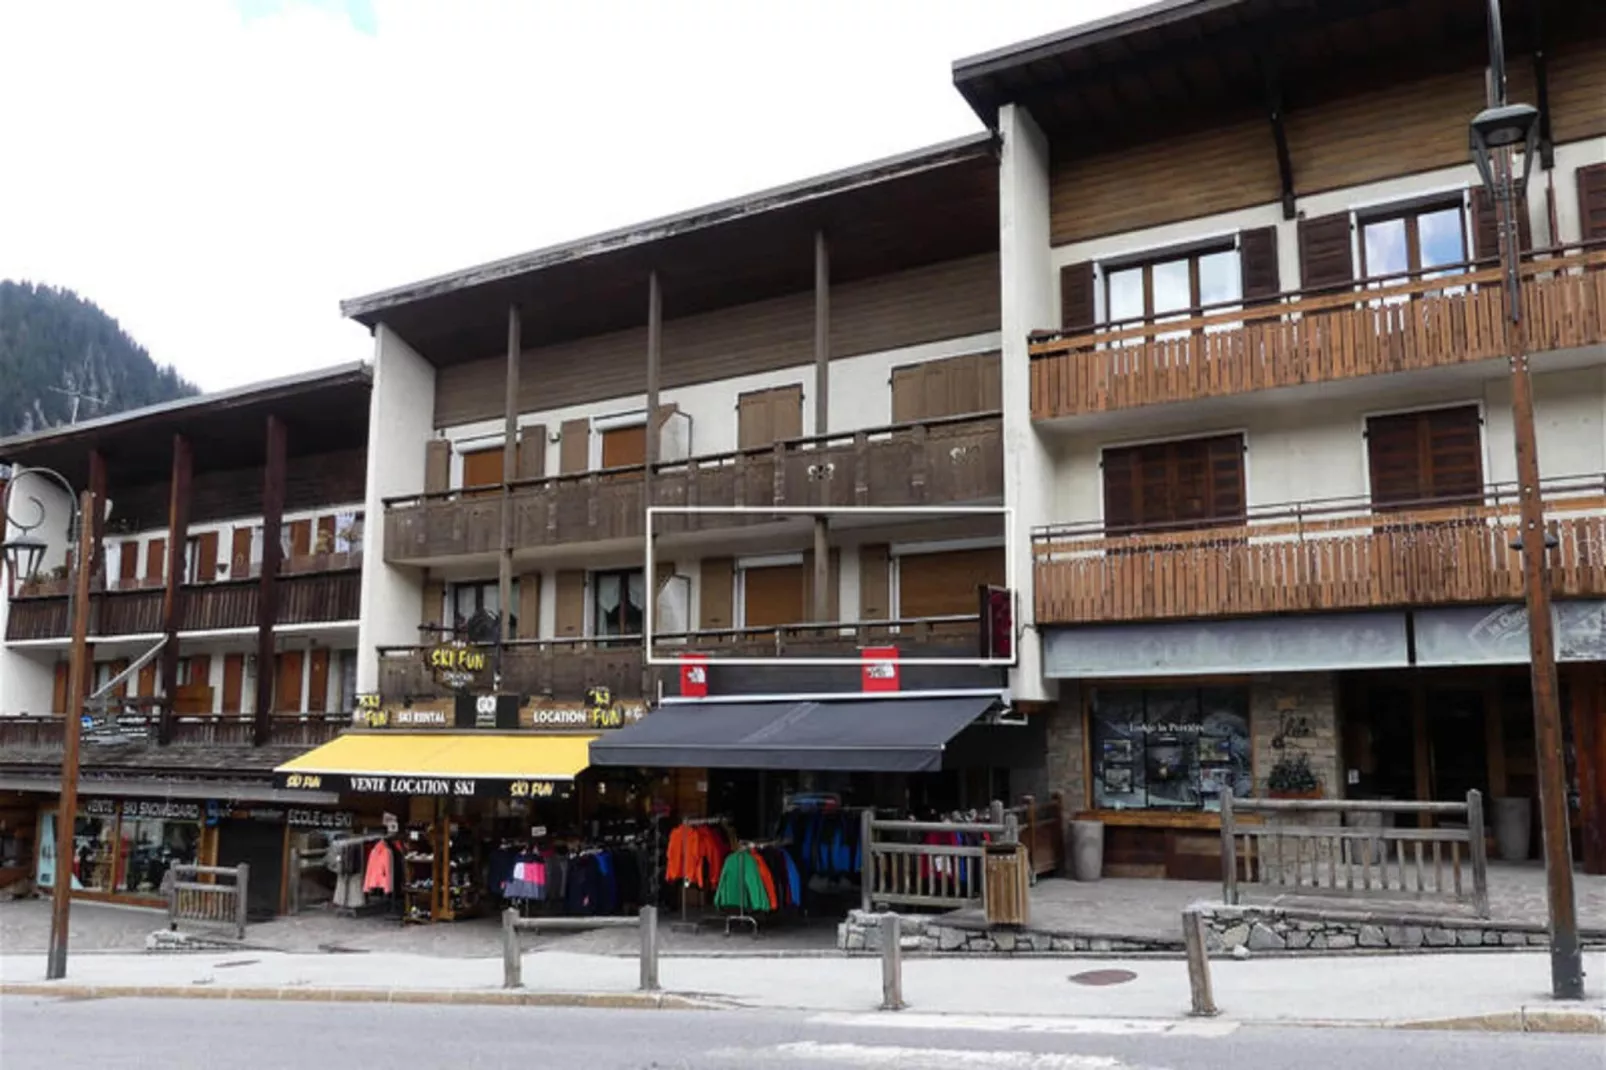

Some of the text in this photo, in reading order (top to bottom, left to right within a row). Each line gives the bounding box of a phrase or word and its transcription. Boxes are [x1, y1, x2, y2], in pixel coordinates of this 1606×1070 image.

[432, 648, 485, 670] SKI FUN
[533, 707, 586, 723] LOCATION
[593, 706, 620, 726] FUN
[350, 777, 476, 795] VENTE LOCATION SKI
[510, 782, 554, 798] SKI FUN
